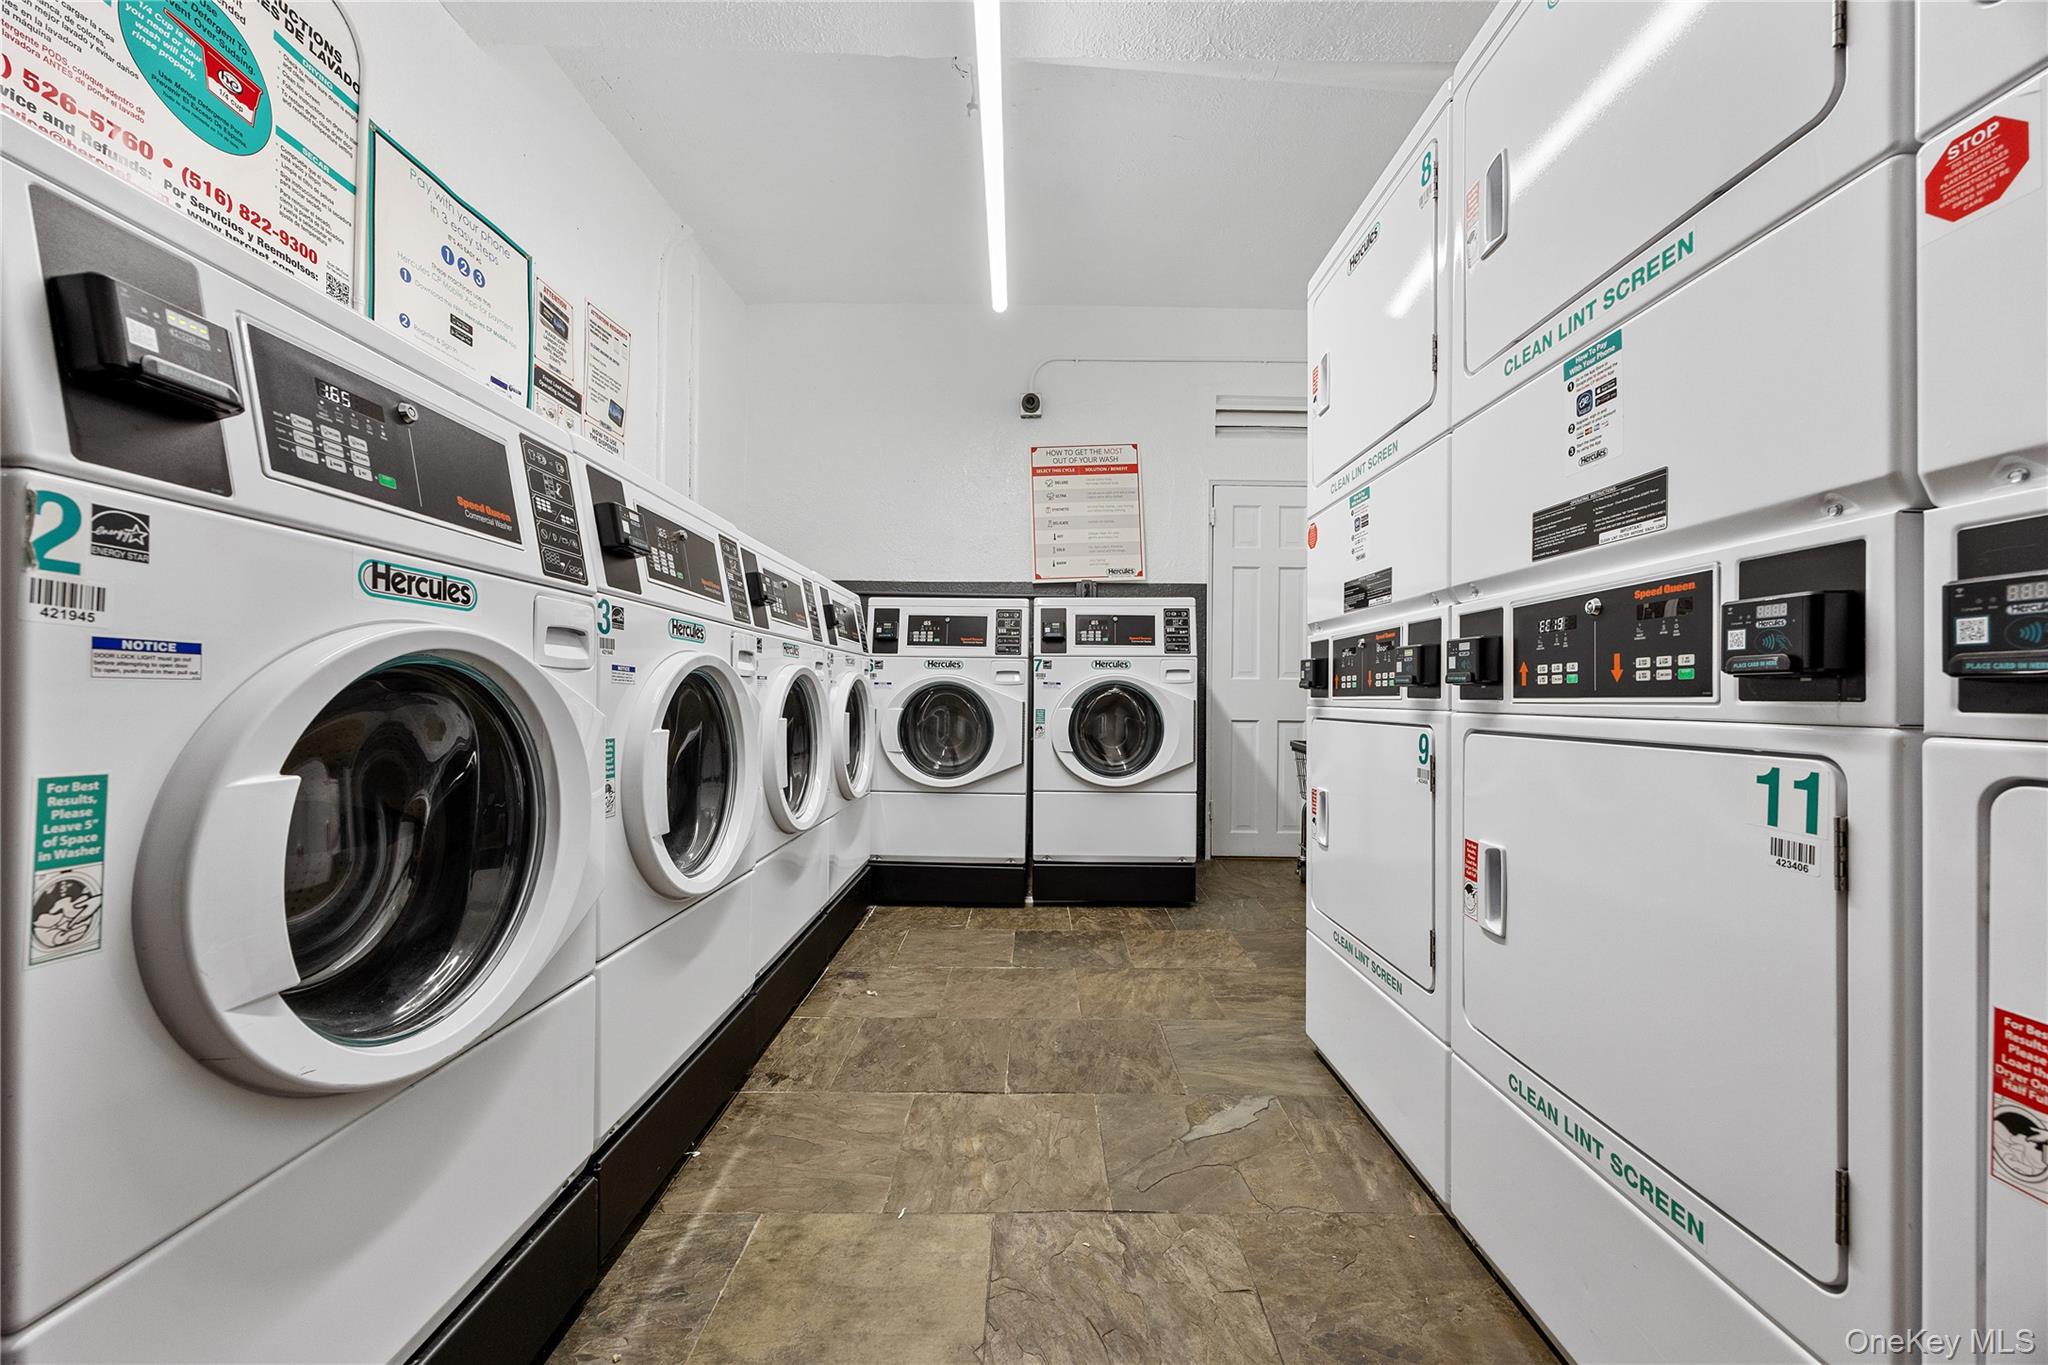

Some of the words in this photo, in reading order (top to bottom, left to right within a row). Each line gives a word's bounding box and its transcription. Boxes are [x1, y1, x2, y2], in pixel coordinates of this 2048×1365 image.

[20, 10, 32, 20] en
[45, 23, 82, 53] lavadora
[35, 4, 60, 24] mejor
[62, 21, 88, 44] lavado
[61, 1, 88, 22] cargar
[98, 27, 114, 43] ropa
[64, 15, 74, 26] de
[125, 2, 144, 21] you
[146, 18, 170, 39] need
[183, 43, 202, 63] your
[154, 12, 174, 32] Cup
[184, 34, 196, 48] all
[191, 2, 236, 46] Detergent
[238, 40, 248, 56] To
[132, 30, 158, 52] rinse
[158, 49, 197, 82] properly.
[134, 21, 160, 42] wash
[162, 40, 178, 56] will
[180, 52, 194, 68] not
[194, 17, 256, 76] Over-Sudsing.
[285, 18, 305, 45] DE
[309, 41, 360, 95] LAVADO
[2, 28, 41, 58] lavadora
[42, 56, 73, 79] ANTES
[87, 84, 110, 103] poner
[119, 103, 145, 124] lavado
[72, 65, 104, 90] coloque
[105, 87, 134, 109] adentro
[302, 59, 334, 90] DRYING
[23, 68, 154, 160] 526-5760
[230, 98, 245, 114] cup
[43, 111, 76, 137] and
[81, 131, 152, 180] Refunds:
[1948, 121, 2000, 160] STOP
[1421, 151, 1432, 187] 8
[1940, 170, 1970, 190] PLASTIC
[1971, 148, 2009, 173] ARTICLES
[1951, 160, 1962, 170] DO
[1963, 150, 1978, 162] NOT
[1980, 142, 1996, 154] DRY
[1942, 172, 1988, 200] SYNTHETICS
[1989, 162, 2006, 174] AND
[1976, 174, 1998, 189] MUST
[1998, 167, 2010, 177] BE
[1976, 183, 1996, 196] WITH
[182, 166, 232, 213] (516)
[239, 203, 318, 264] 822-9300
[410, 168, 432, 194] Pay
[434, 190, 456, 214] with
[456, 209, 479, 233] your
[480, 230, 511, 260] phone
[1963, 196, 1984, 211] CARE
[164, 179, 187, 200] Por
[190, 195, 244, 236] Servicios
[256, 236, 320, 282] Reembolsos:
[430, 201, 440, 218] in
[450, 221, 474, 247] easy
[474, 240, 500, 266] steps
[1504, 330, 1553, 376] CLEAN
[1558, 299, 1597, 342] LINT
[1603, 231, 1694, 310] SCREEN
[1568, 364, 1582, 376] With
[1582, 356, 1596, 370] Your
[1596, 345, 1616, 362] Phone
[1576, 352, 1588, 364] How
[1596, 340, 1608, 354] Pay
[1330, 472, 1350, 494] CLEAN
[1351, 460, 1367, 480] LINT
[1368, 440, 1398, 470] SCREEN
[1580, 448, 1606, 465] Hercules
[456, 496, 484, 512] Speed
[485, 506, 512, 522] Queen
[464, 510, 494, 526] Commercial
[495, 520, 512, 532] Washer
[32, 490, 82, 576] 2
[1620, 524, 1642, 533] IMPORTANT
[92, 546, 126, 560] ENERGY
[126, 550, 150, 563] STAR
[372, 561, 471, 605] Hercules
[1634, 586, 1662, 600] Speed
[1664, 582, 1696, 595] Queen
[40, 608, 96, 623] 421945
[598, 598, 611, 634] 3
[672, 620, 704, 640] Hercules
[1758, 619, 1785, 628] Hercules
[121, 640, 178, 652] NOTICE
[928, 660, 961, 668] Hercules
[1034, 659, 1042, 672] 7
[1094, 660, 1128, 668] Hercules
[1733, 661, 1747, 669] PLACE
[1748, 660, 1760, 668] CARD
[1418, 733, 1429, 765] 9
[46, 782, 69, 794] For
[72, 780, 100, 792] Best
[47, 794, 97, 807] Results,
[1756, 766, 1820, 836] 11
[42, 822, 81, 834] Leave
[51, 808, 93, 820] Please
[38, 851, 52, 862] in
[54, 844, 102, 860] Washer
[42, 836, 56, 848] of
[59, 833, 98, 848] Space
[1776, 858, 1809, 873] 423406
[1333, 930, 1354, 955] CLEAN
[1354, 946, 1370, 968] LINT
[1371, 960, 1403, 996] SCREEN
[2004, 1016, 2024, 1031] For
[2001, 1053, 2032, 1073] Load
[2008, 1043, 2048, 1066] Please
[1996, 1063, 2028, 1084] Dryer
[2002, 1079, 2027, 1097] Half
[1508, 1073, 1558, 1126] CLEAN
[1564, 1115, 1604, 1161] LINT
[1610, 1152, 1704, 1245] SCREEN
